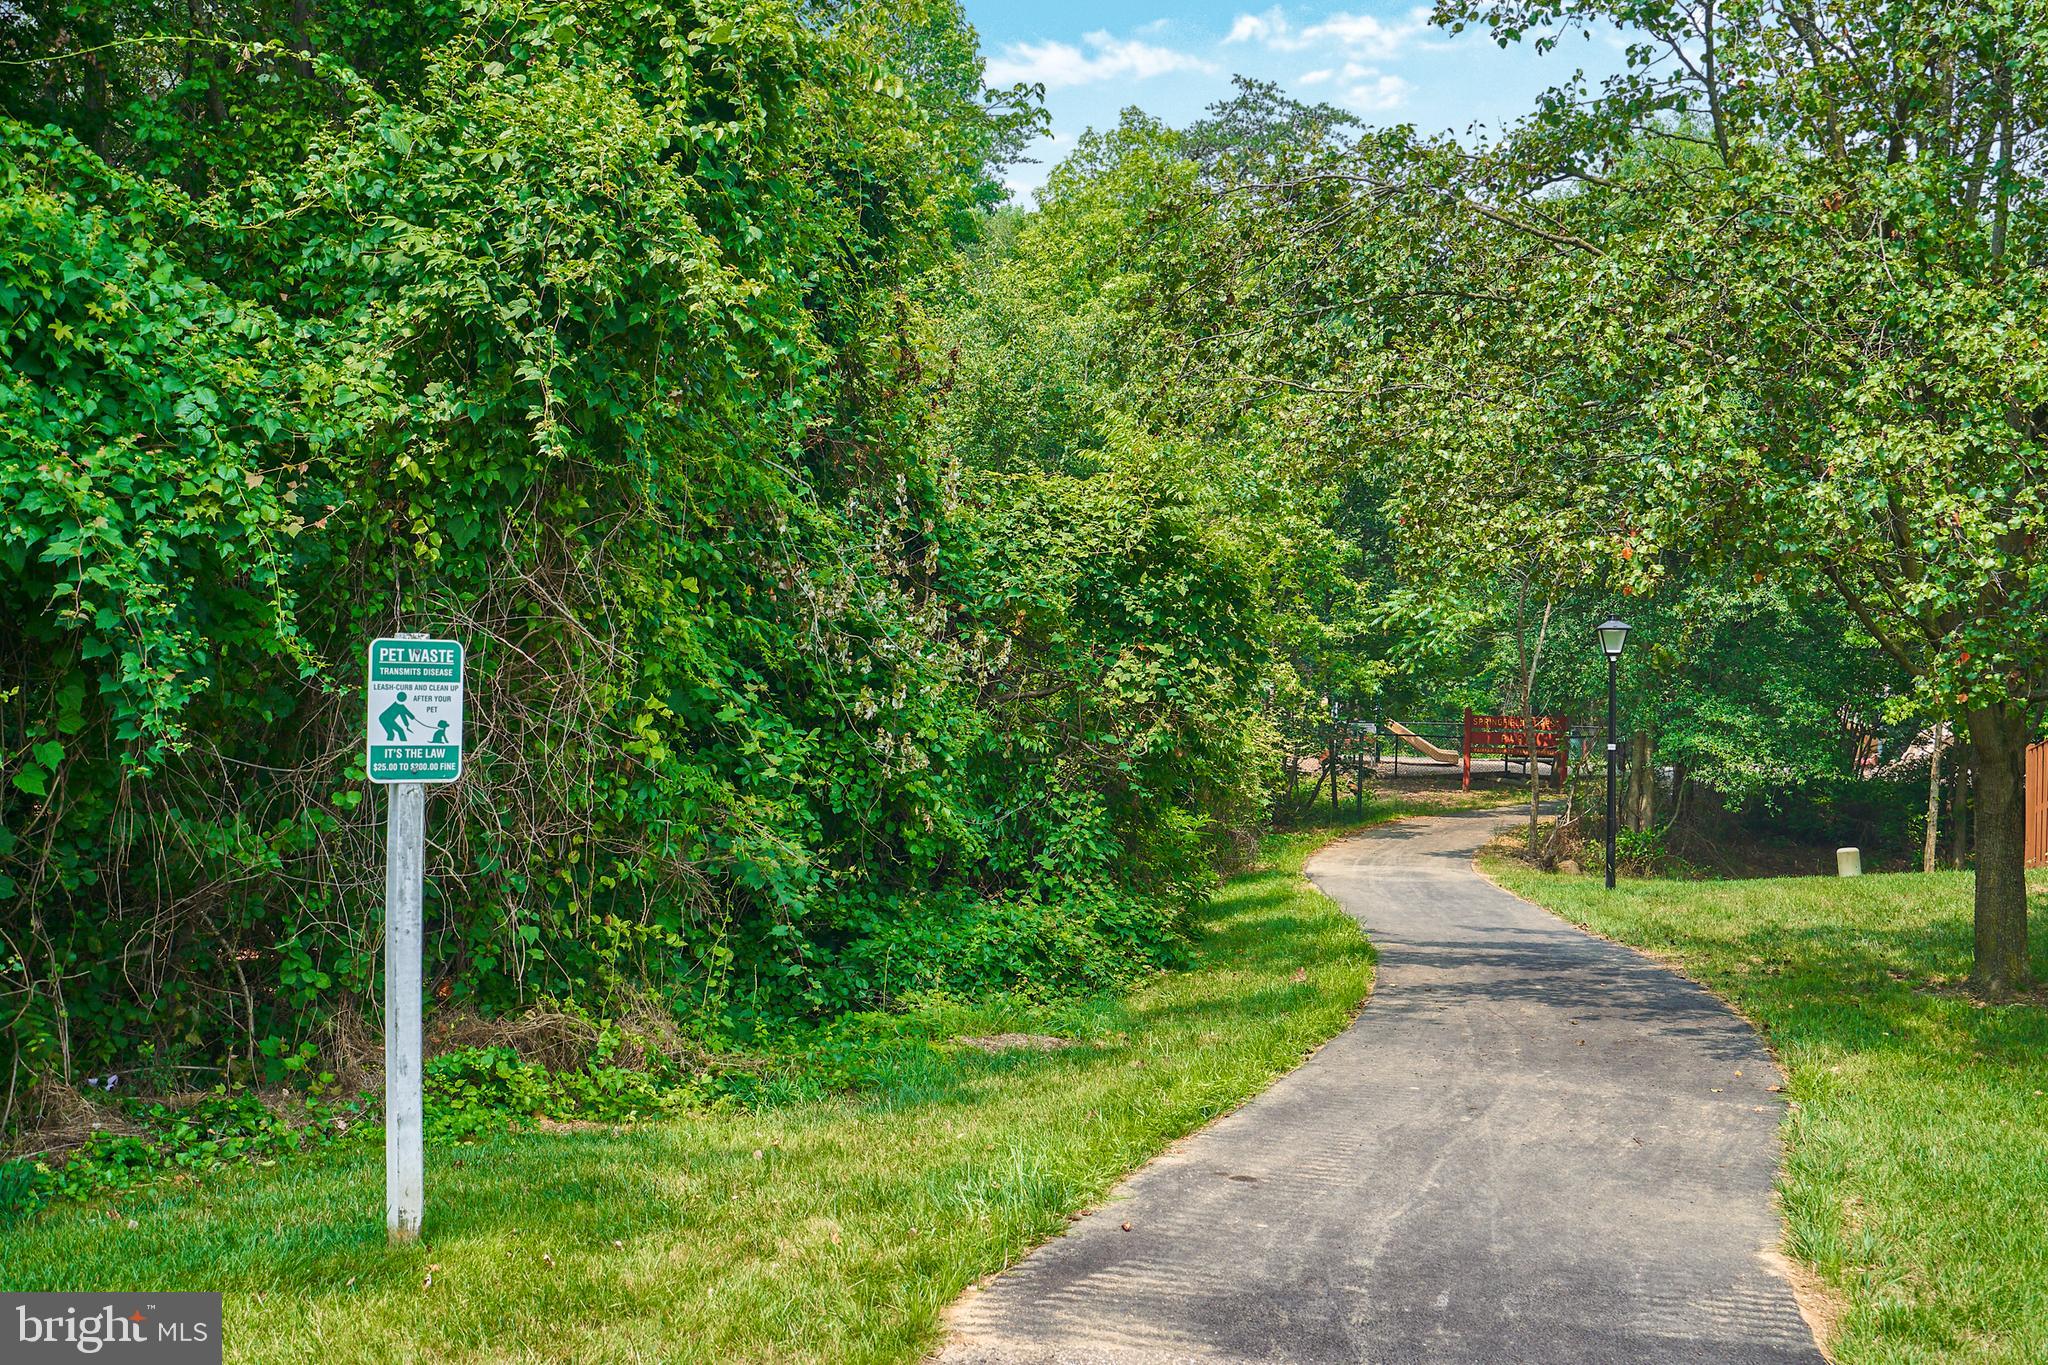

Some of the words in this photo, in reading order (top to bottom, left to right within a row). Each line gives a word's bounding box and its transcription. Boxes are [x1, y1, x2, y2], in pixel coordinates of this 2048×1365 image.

[380, 648, 405, 661] PET
[408, 648, 454, 663] WASTE
[380, 667, 421, 676] TRANSMITS
[423, 668, 453, 676] DISEASE
[373, 683, 413, 691] LEASH-CURB
[384, 748, 402, 758] IT'S
[405, 748, 423, 758] THE
[425, 748, 446, 758] LAW
[373, 763, 397, 771] $25.00
[410, 763, 439, 771] $200.00
